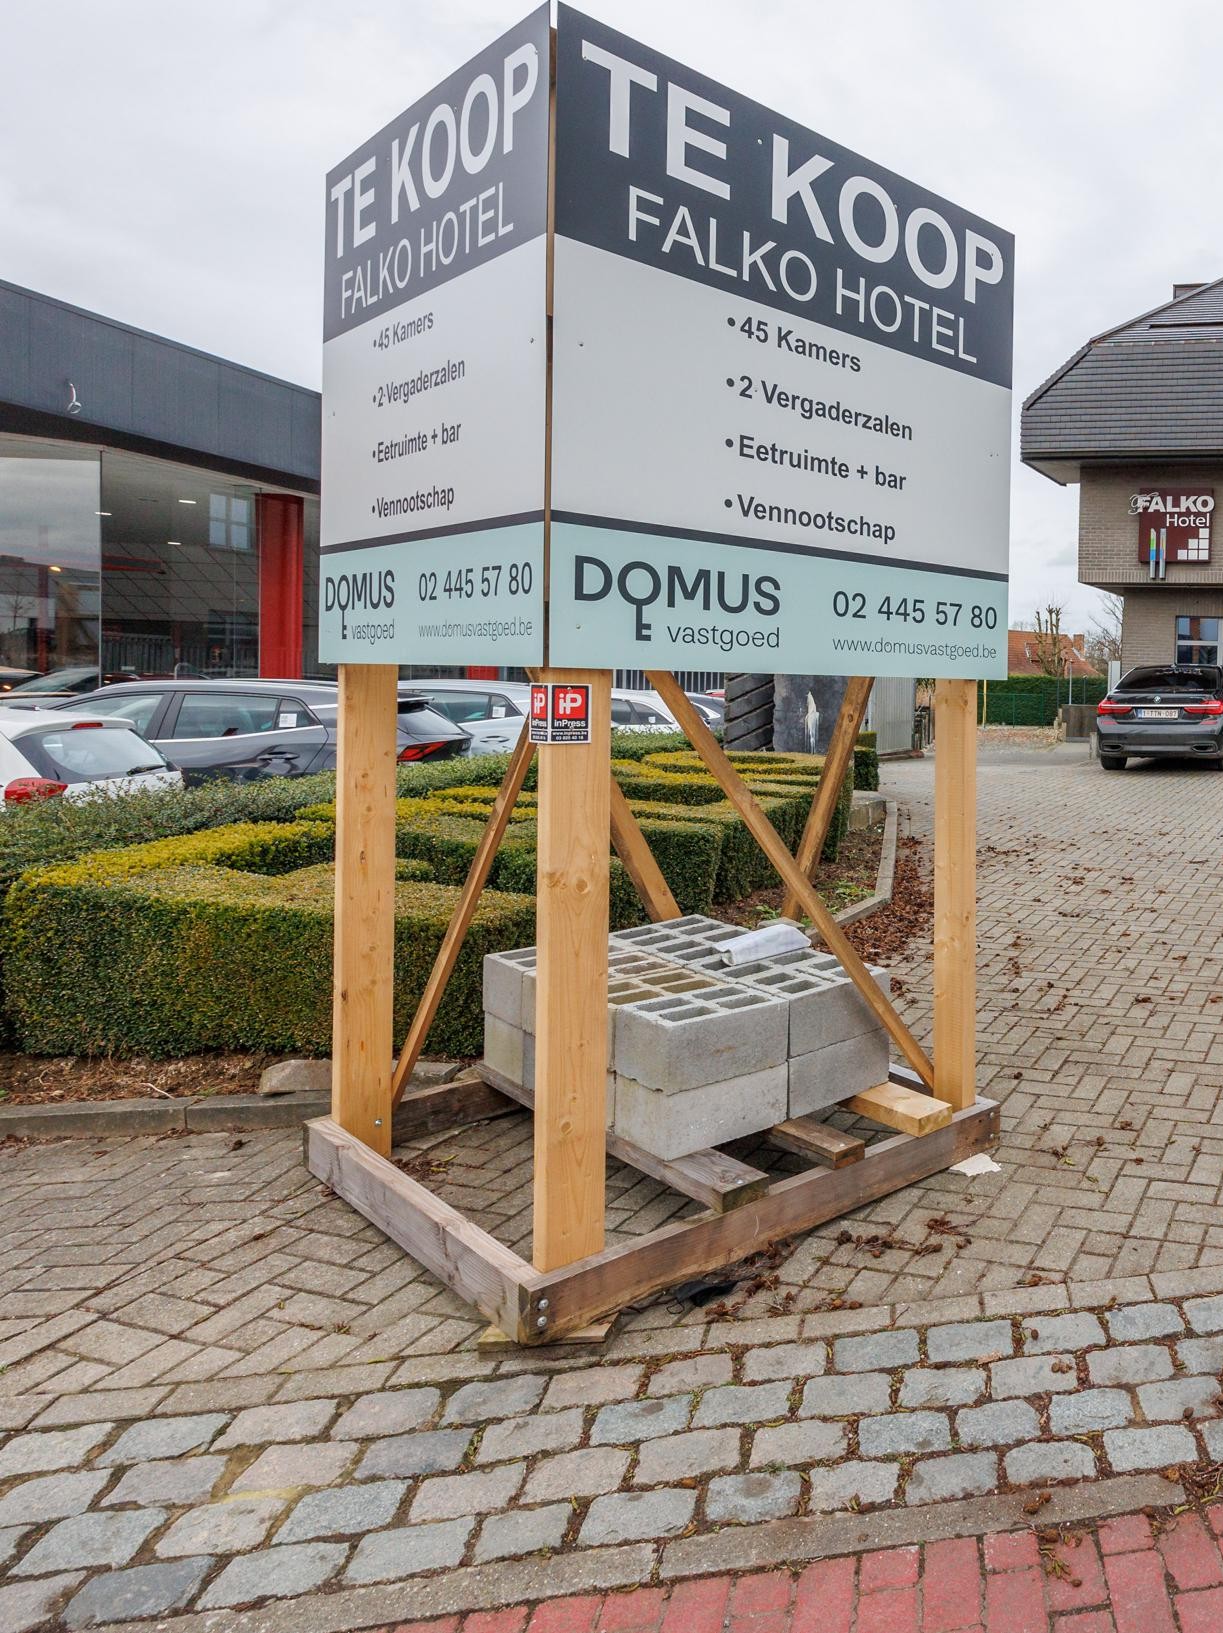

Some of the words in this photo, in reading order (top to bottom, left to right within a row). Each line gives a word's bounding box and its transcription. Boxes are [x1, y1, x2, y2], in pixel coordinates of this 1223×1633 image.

[331, 156, 376, 258] TE
[391, 42, 539, 225] KOOP
[581, 39, 730, 200] TE
[771, 133, 1004, 304] KOOP
[341, 238, 412, 319] FALKO
[420, 182, 514, 277] HOTEL
[628, 184, 818, 302] FALKO
[836, 267, 977, 364] HOTEL
[378, 327, 390, 350] 45
[392, 312, 434, 345] Kamers
[740, 315, 769, 344] 45
[777, 326, 862, 373] Kamers
[377, 386, 384, 408] 2
[386, 359, 465, 404] Vergaderzalen
[739, 375, 753, 399] 2
[761, 380, 913, 441] Vergaderzalen
[377, 432, 428, 463] Eetruimte
[431, 428, 438, 445] +
[441, 422, 462, 445] bar
[739, 434, 850, 480] Eetruimte
[856, 466, 868, 482] +
[875, 465, 907, 491] bar
[376, 485, 455, 518] Vennootschap
[737, 494, 896, 544] Vennootschap
[1128, 492, 1215, 514] FALKO
[1166, 512, 1210, 527] Hotel
[325, 569, 395, 612] DOMUS
[418, 572, 437, 601] 02
[443, 568, 474, 600] 445
[481, 565, 502, 597] 57
[508, 561, 533, 595] 80
[574, 554, 781, 617] DOMUS
[418, 616, 533, 642] www.domusvastgoed.be
[832, 590, 867, 619] 02
[877, 595, 926, 624] 445
[935, 601, 962, 627] 57
[970, 605, 998, 631] 80
[351, 619, 395, 645] vastgoed
[667, 623, 780, 652] vastgoed
[832, 636, 998, 661] www.domusvastgoed.be
[554, 720, 586, 728] inPress
